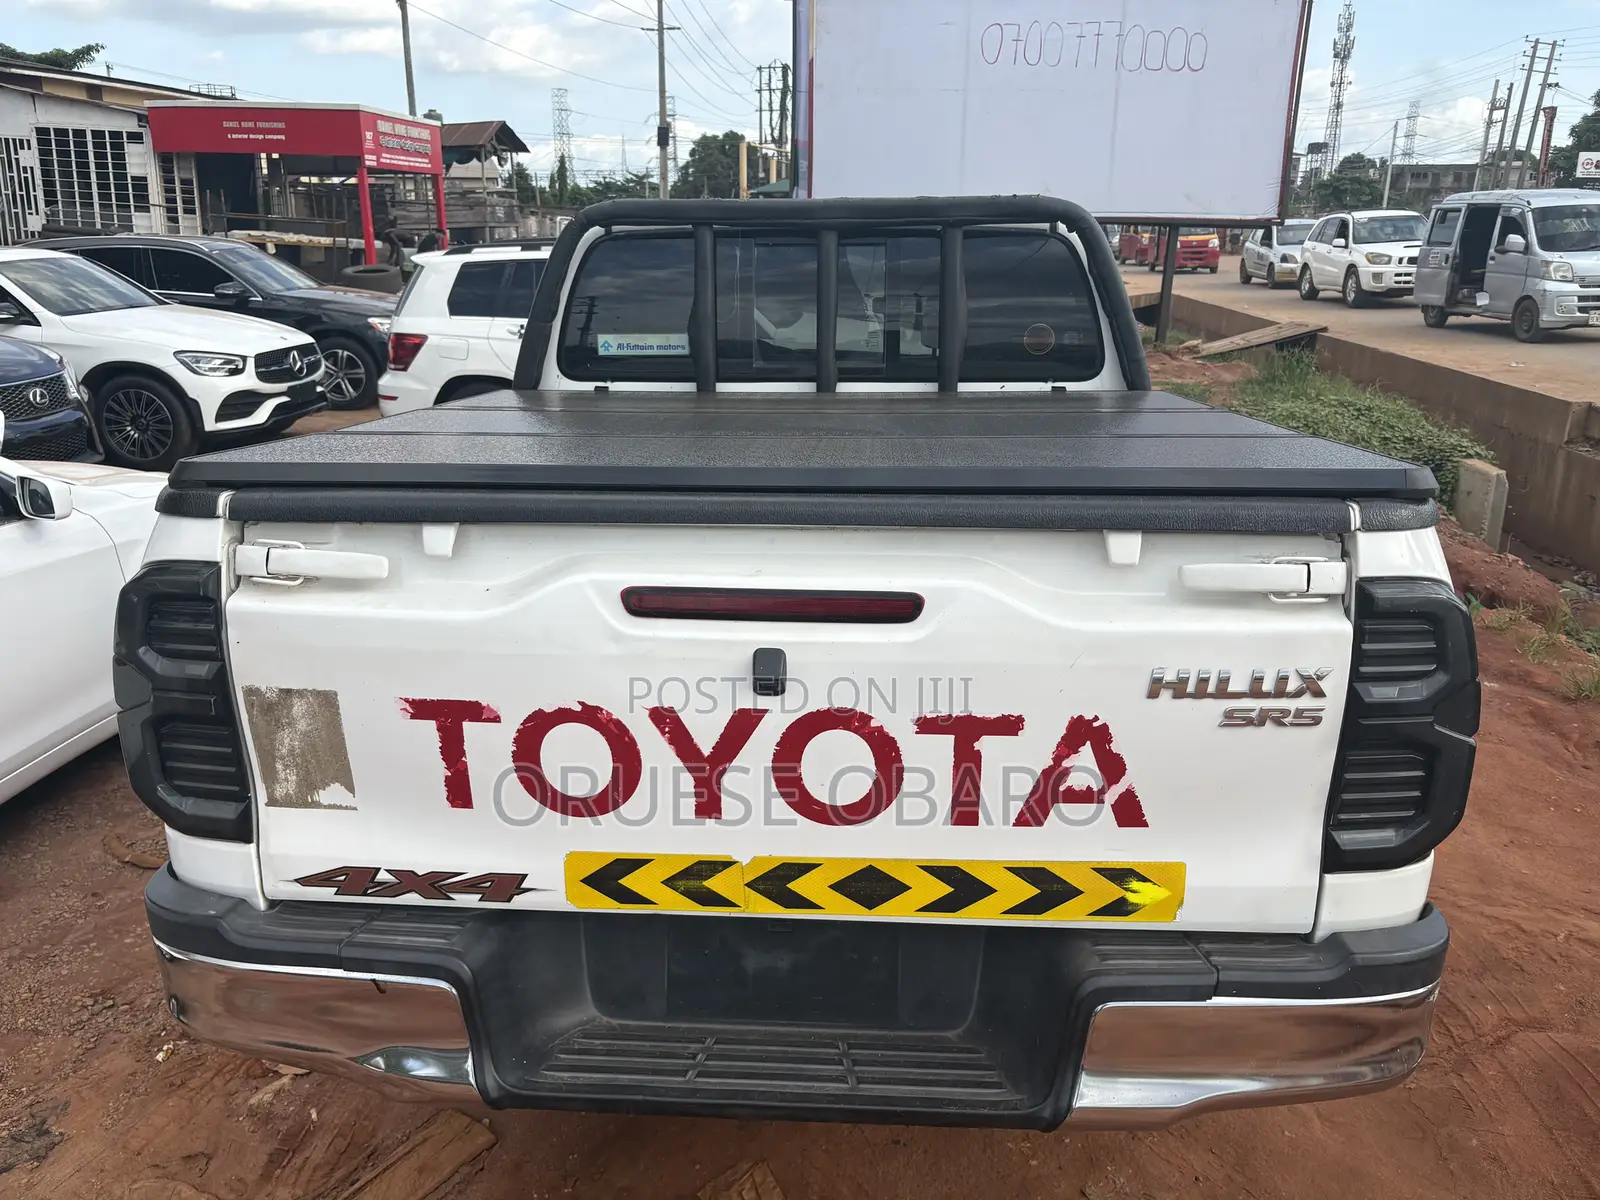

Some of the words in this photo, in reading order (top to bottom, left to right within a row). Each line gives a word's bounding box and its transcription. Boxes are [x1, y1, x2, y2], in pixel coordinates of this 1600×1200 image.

[981, 20, 1208, 72] 07007770000
[1218, 705, 1327, 727] SR5
[396, 697, 1150, 827] TOYOTA
